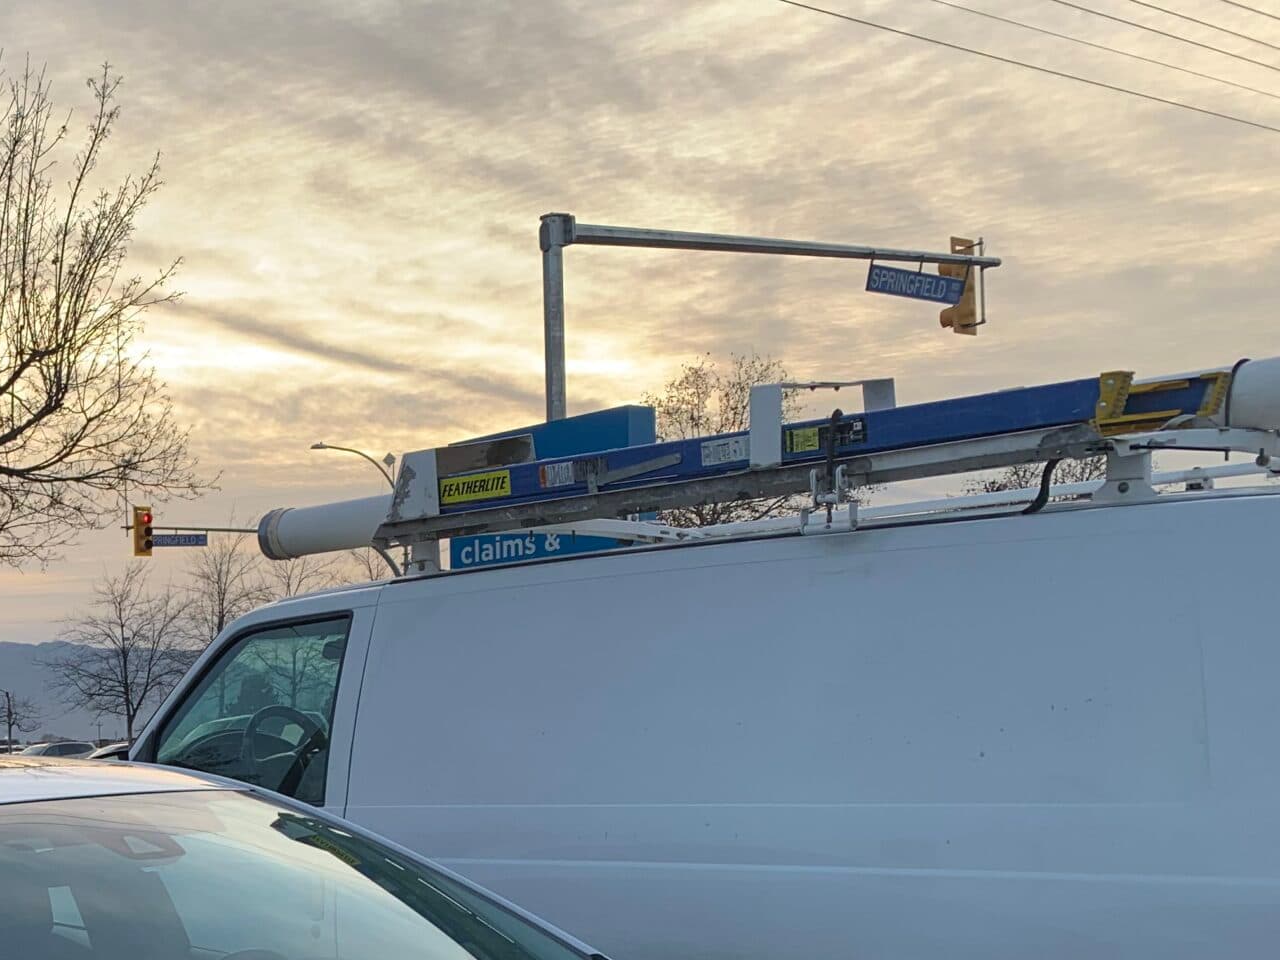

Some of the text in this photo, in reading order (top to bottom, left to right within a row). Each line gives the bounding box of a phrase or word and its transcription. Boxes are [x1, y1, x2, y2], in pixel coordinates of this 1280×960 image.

[871, 268, 946, 298] SPRINGFIELD
[441, 474, 508, 498] FEATHERLITE
[152, 535, 197, 545] PRINGFIELD
[461, 532, 561, 564] claims &
